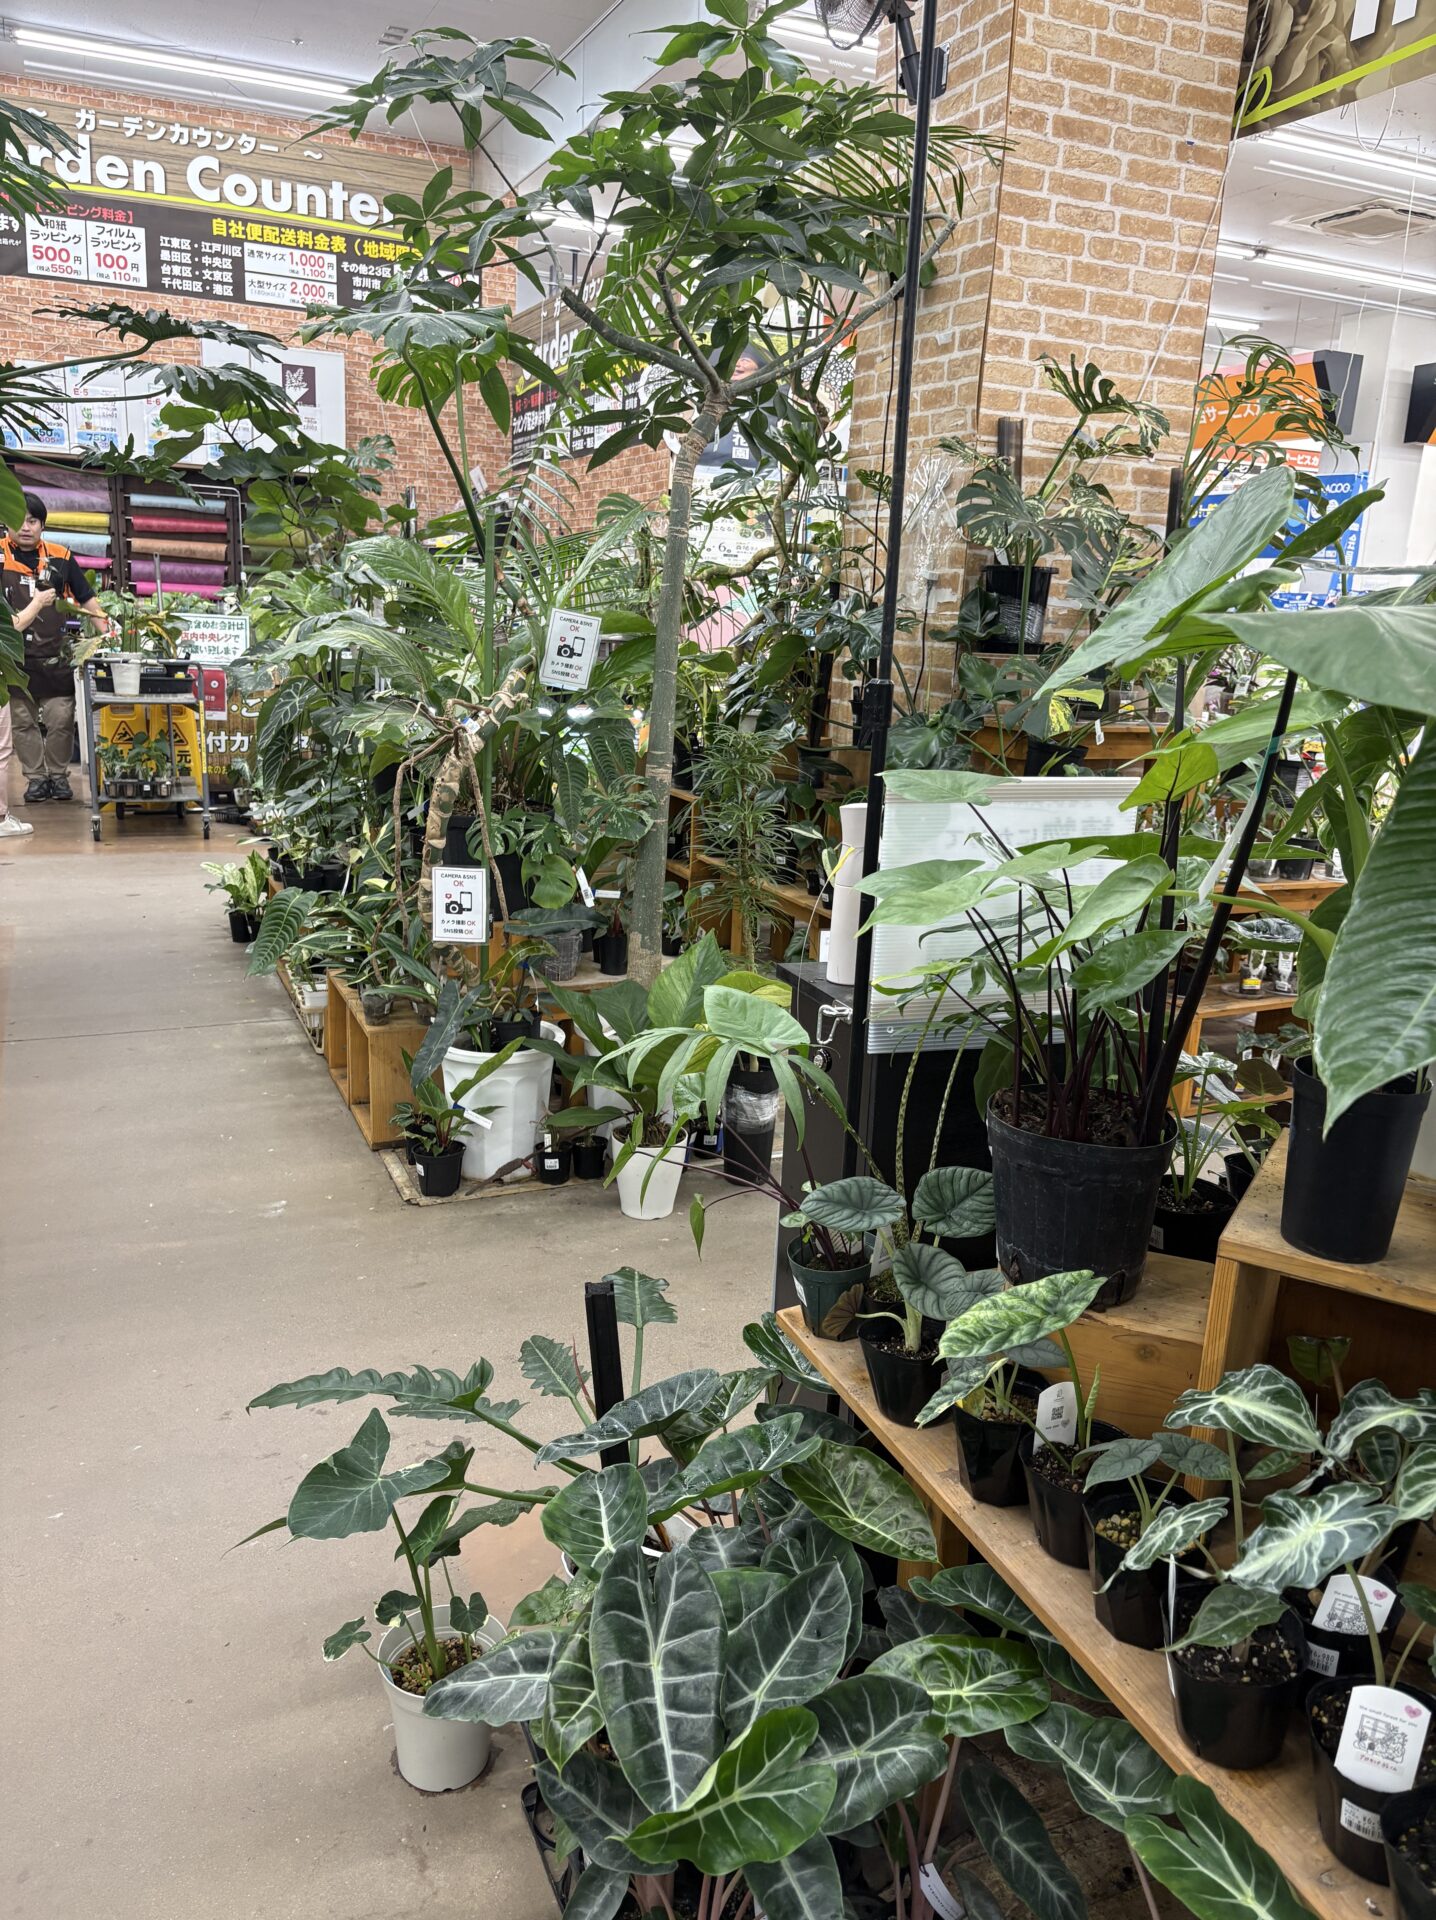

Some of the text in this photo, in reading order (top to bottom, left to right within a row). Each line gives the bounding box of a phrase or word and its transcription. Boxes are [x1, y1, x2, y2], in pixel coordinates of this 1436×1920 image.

[75, 108, 279, 155] ガーデンカウンター
[30, 229, 82, 245] ラッピング
[95, 225, 136, 240] フィルム
[90, 236, 142, 253] ラッピング
[247, 247, 286, 262] 通常サイズ
[248, 279, 287, 292] 大型サイズ
[560, 616, 579, 625] CAMERA
[569, 624, 580, 633] OK
